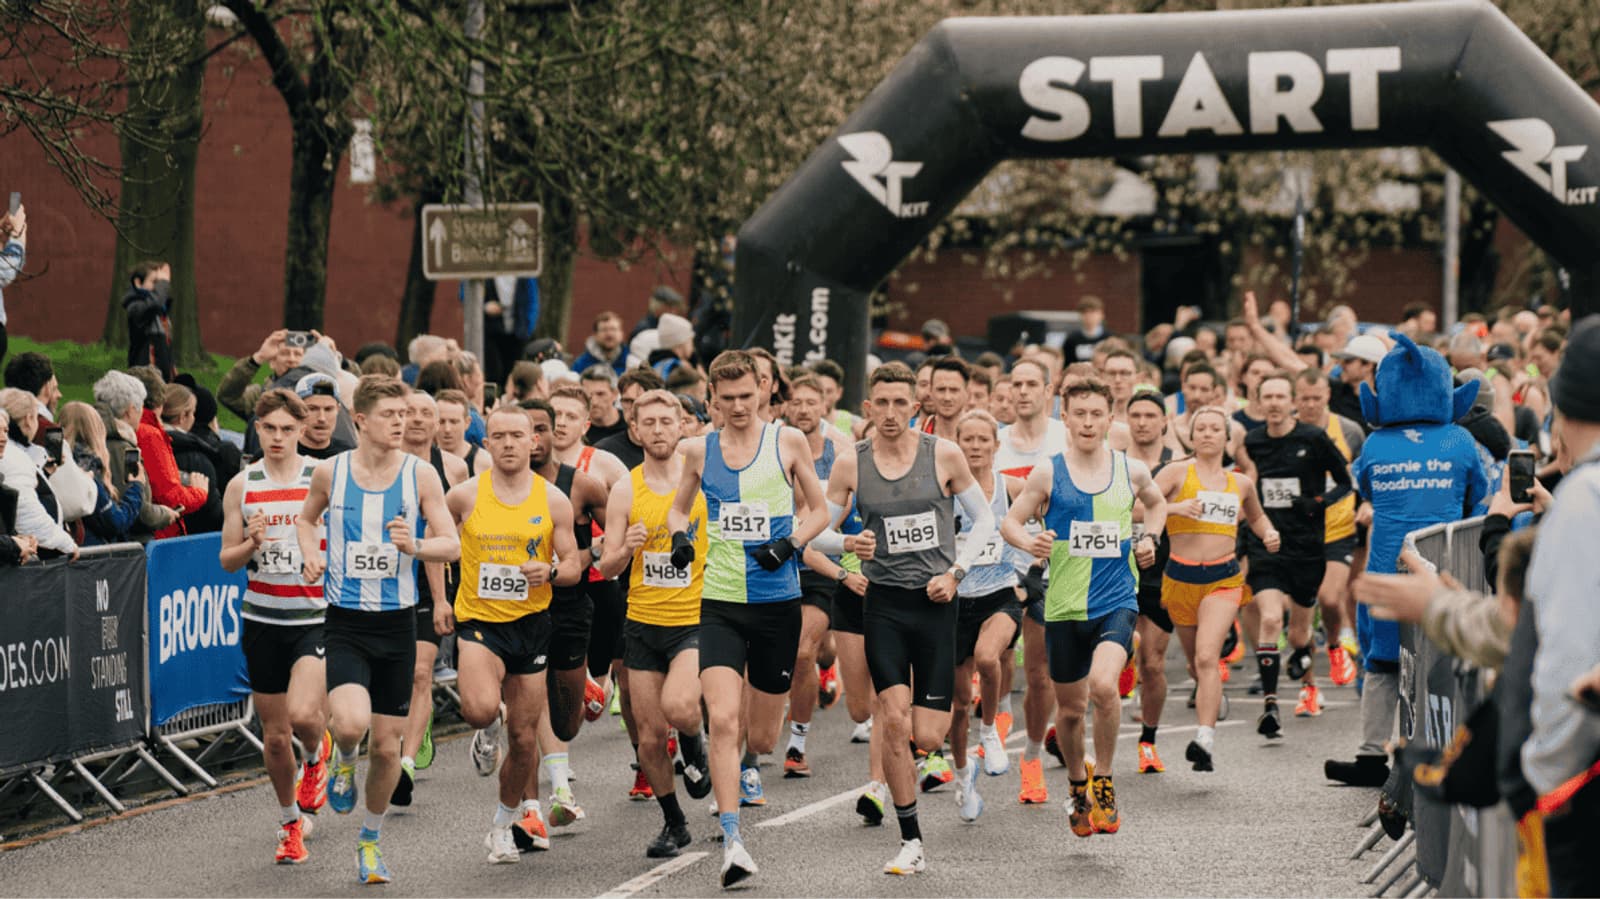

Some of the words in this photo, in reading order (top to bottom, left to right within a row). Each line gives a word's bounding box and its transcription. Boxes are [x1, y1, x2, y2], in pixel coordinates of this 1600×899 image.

[1019, 46, 1401, 141] START
[1566, 187, 1599, 205] KIT
[902, 201, 929, 218] KIT
[1373, 460, 1421, 475] Ronnie
[1427, 459, 1453, 471] the
[1372, 477, 1453, 491] Roadrunner
[1201, 503, 1236, 517] 1746
[285, 514, 291, 525] &
[722, 517, 766, 532] 1517
[889, 525, 935, 545] 1489
[1072, 535, 1119, 549] 1764
[262, 551, 292, 566] 174
[354, 555, 389, 570] 516
[645, 565, 688, 580] 1486
[481, 576, 527, 593] 1892
[96, 578, 109, 612] NO
[159, 584, 240, 665] BROOKS
[115, 688, 134, 723] STILL
